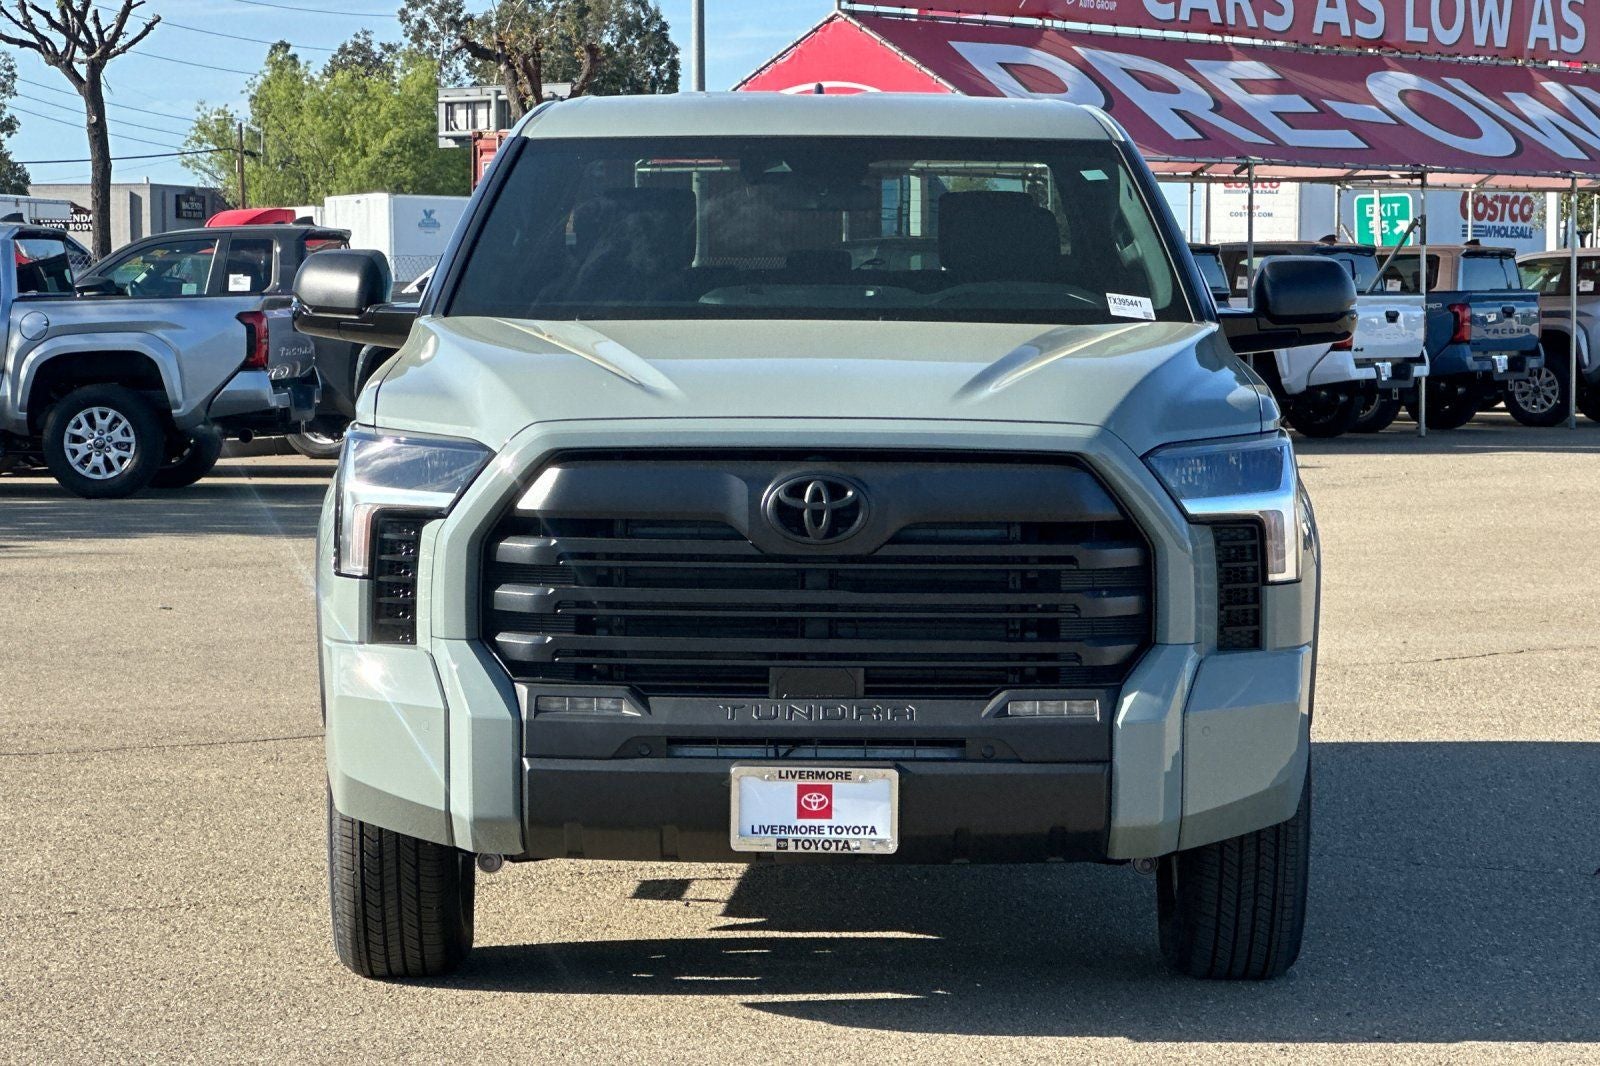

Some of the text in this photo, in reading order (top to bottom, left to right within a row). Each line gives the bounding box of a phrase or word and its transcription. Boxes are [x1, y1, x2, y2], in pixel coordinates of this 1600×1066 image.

[1078, 0, 1095, 9] AUTO
[1096, 0, 1117, 10] GROUP
[1312, 0, 1385, 39] AS
[1405, 0, 1513, 48] LOW
[1527, 0, 1586, 54] AS
[947, 40, 1600, 160] PRE-OW
[1366, 203, 1401, 217] EXIT
[1460, 191, 1534, 223] COSTCO
[69, 223, 93, 231] BODY
[1484, 225, 1533, 239] WHOLESALE
[1108, 296, 1143, 308] TX395441
[1484, 327, 1531, 335] TACOMA
[717, 704, 918, 722] TUNDRA
[778, 769, 853, 781] LIVERMORE
[751, 824, 878, 836] LIVERMORE TOYOTA
[792, 838, 852, 852] TOYOTA
